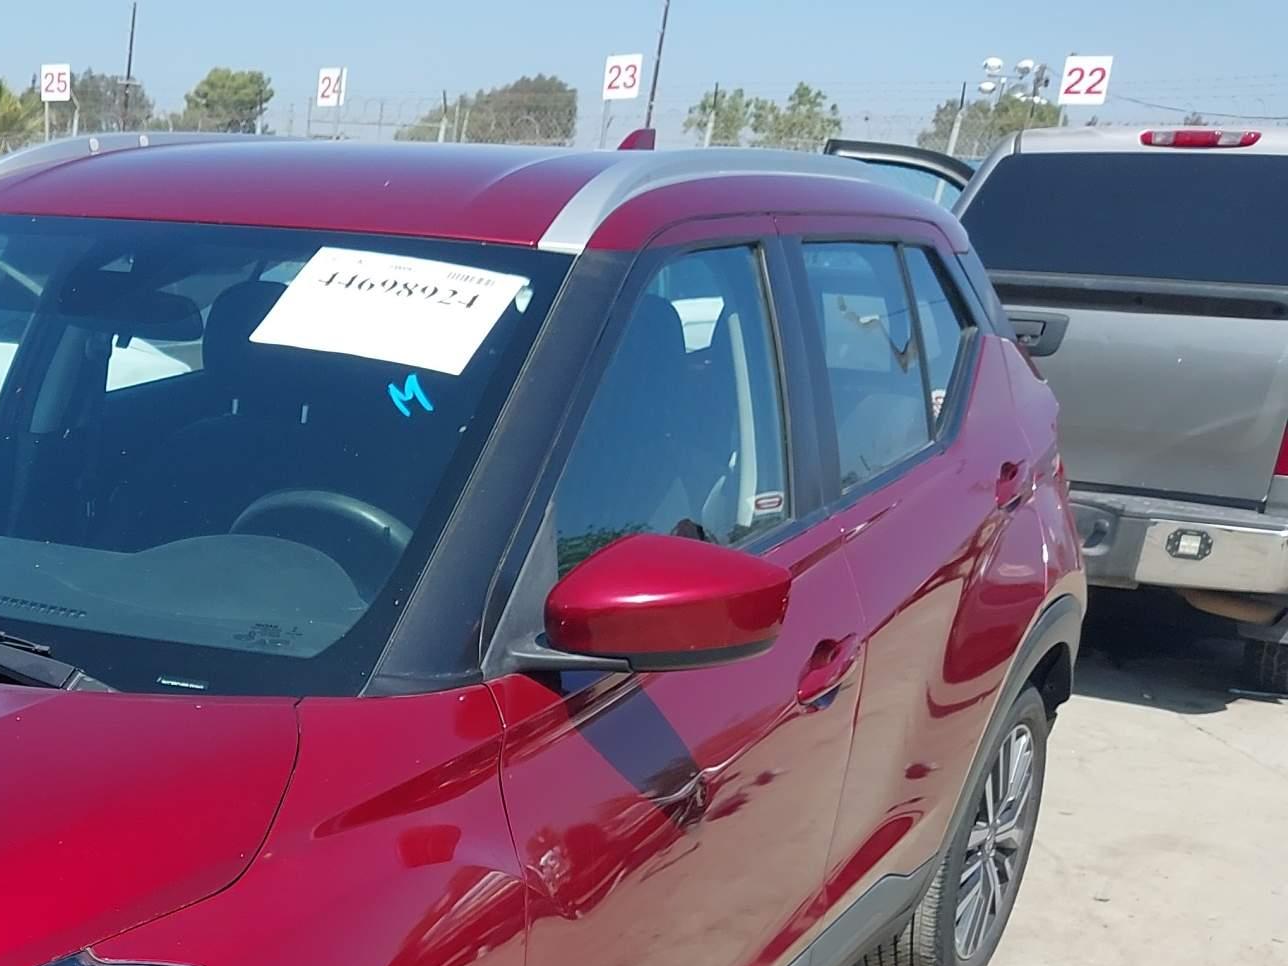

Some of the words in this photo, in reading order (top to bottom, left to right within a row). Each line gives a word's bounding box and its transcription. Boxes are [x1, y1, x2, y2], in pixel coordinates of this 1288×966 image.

[44, 72, 67, 93] 25
[321, 76, 342, 98] 24
[607, 64, 638, 91] 23
[1063, 66, 1107, 95] 22
[318, 271, 480, 308] 44698924
[387, 373, 435, 417] M
